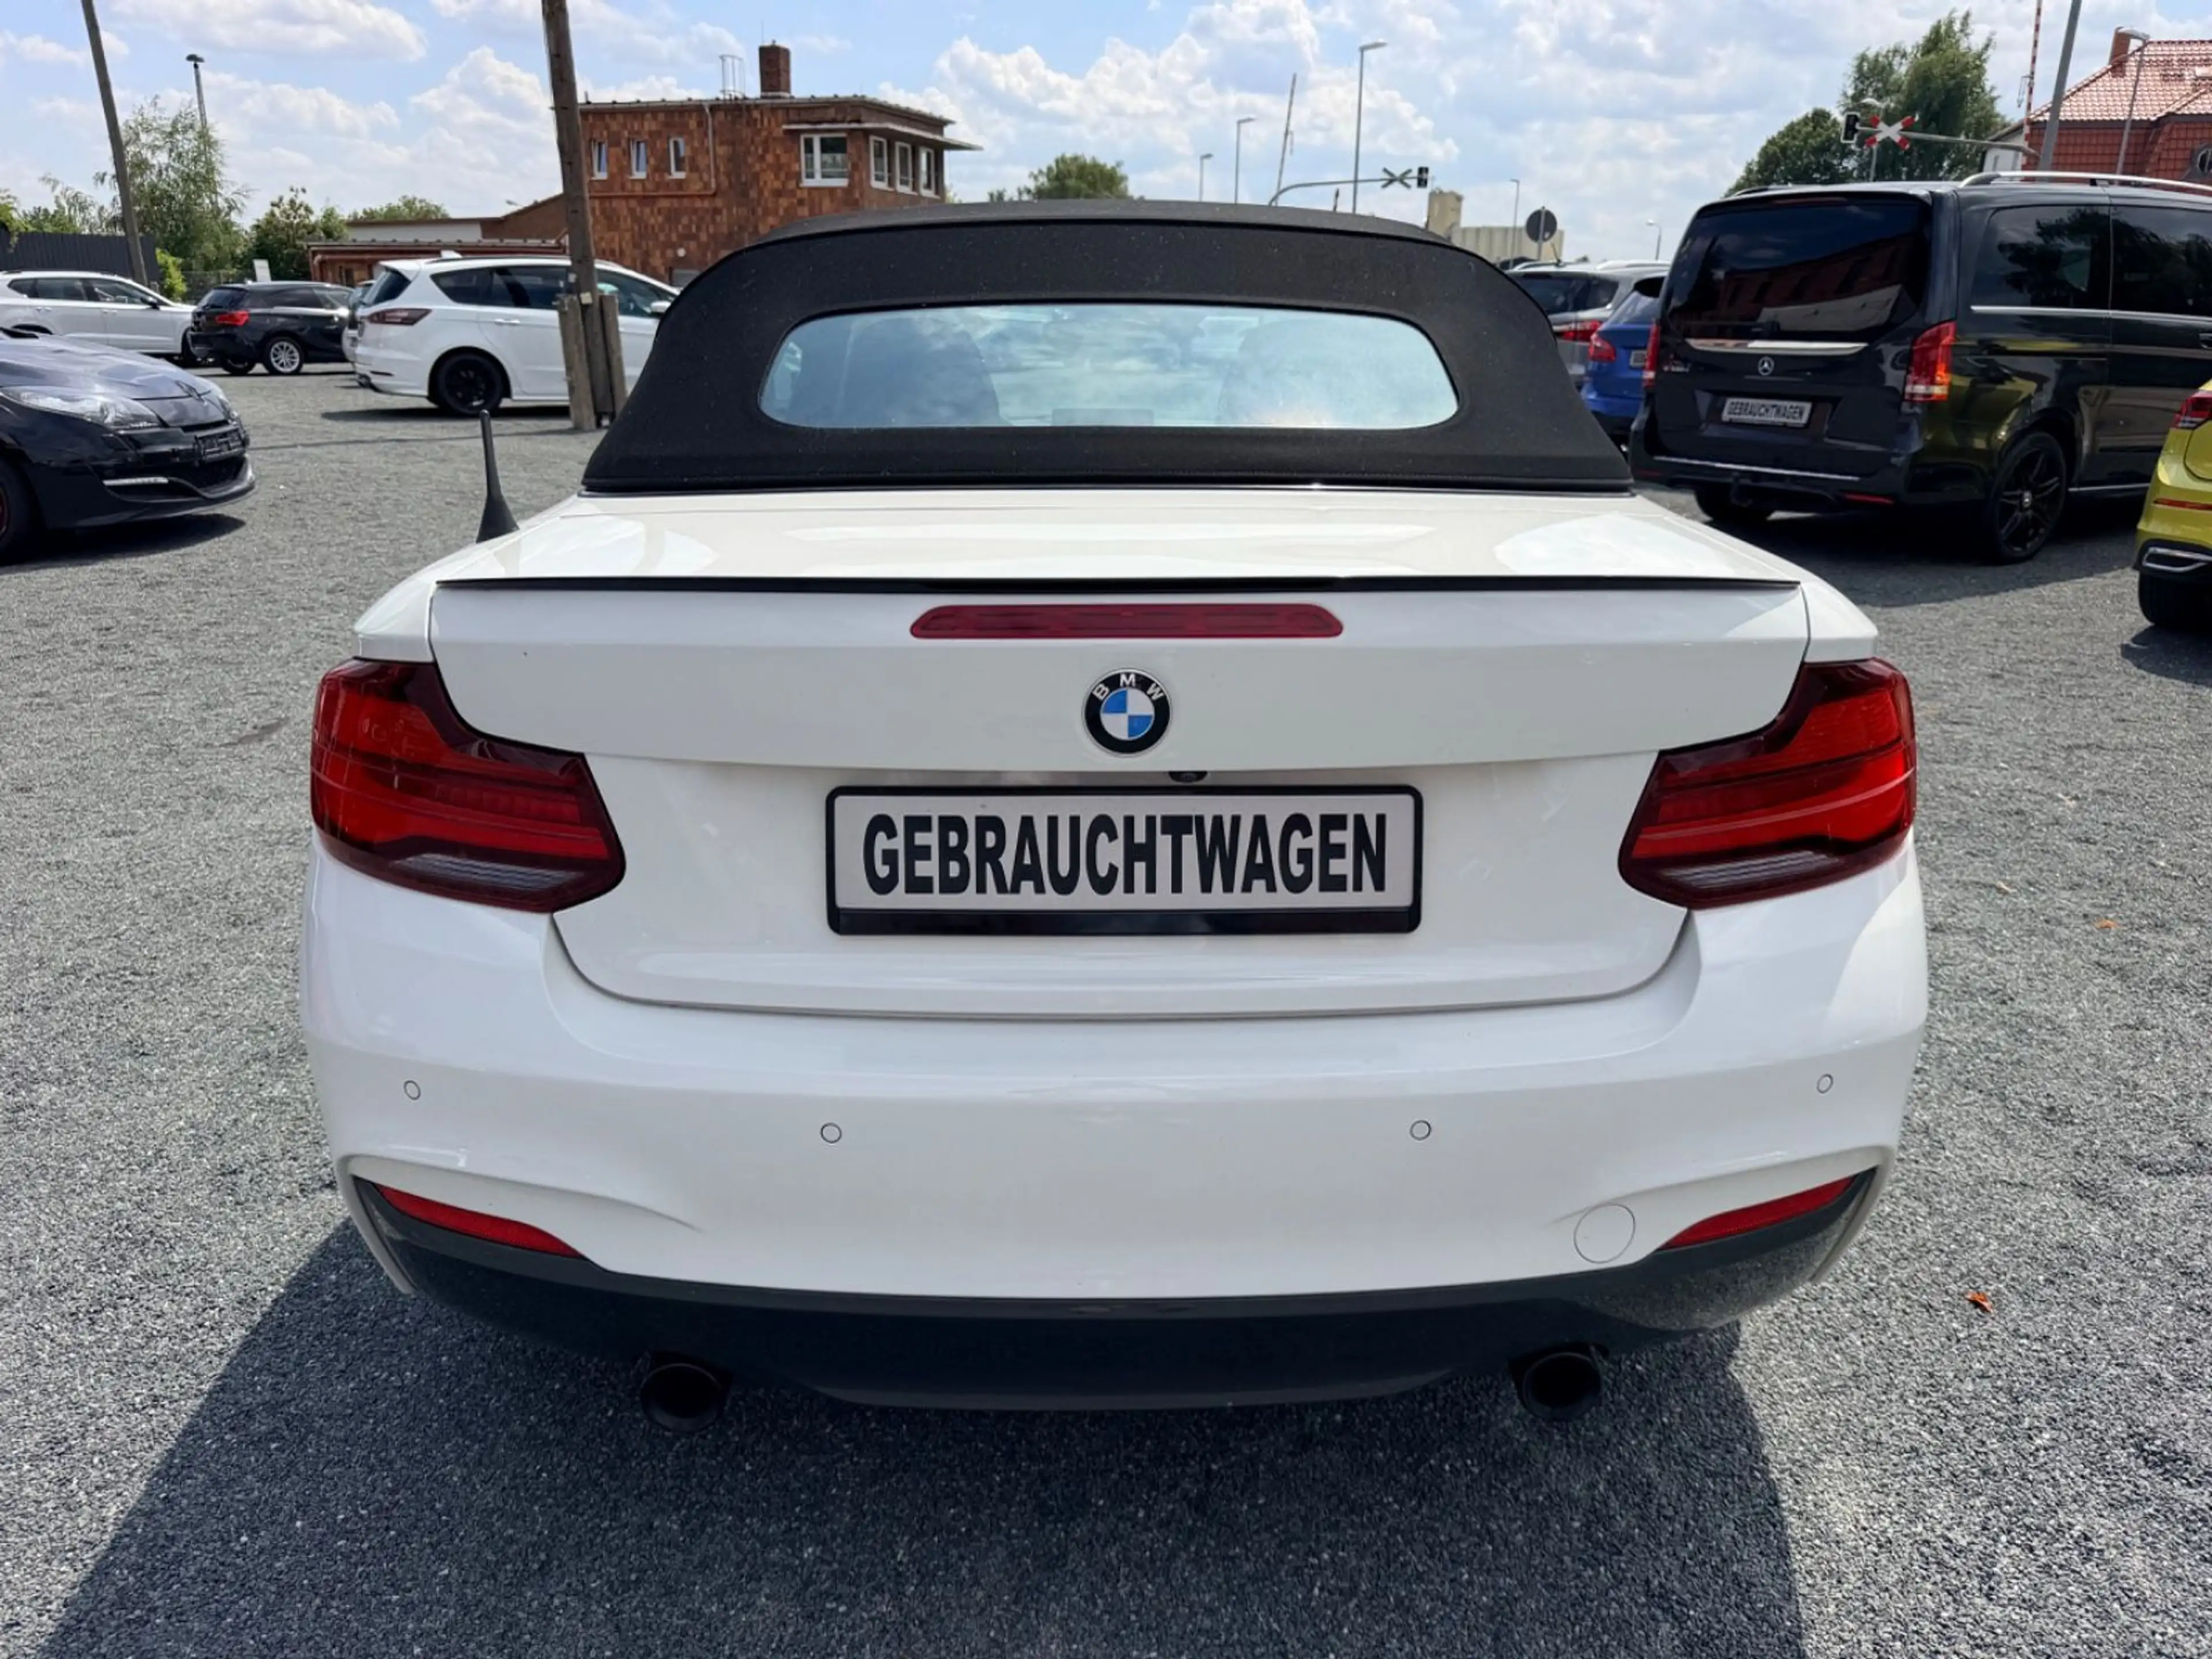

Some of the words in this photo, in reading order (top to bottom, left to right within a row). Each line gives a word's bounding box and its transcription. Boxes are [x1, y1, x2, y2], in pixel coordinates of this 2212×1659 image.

[1728, 401, 1805, 421] GEBRAUCHTWAGEN
[1092, 673, 1164, 700] BMW
[863, 814, 1386, 895] GEBRAUCHTWAGEN
